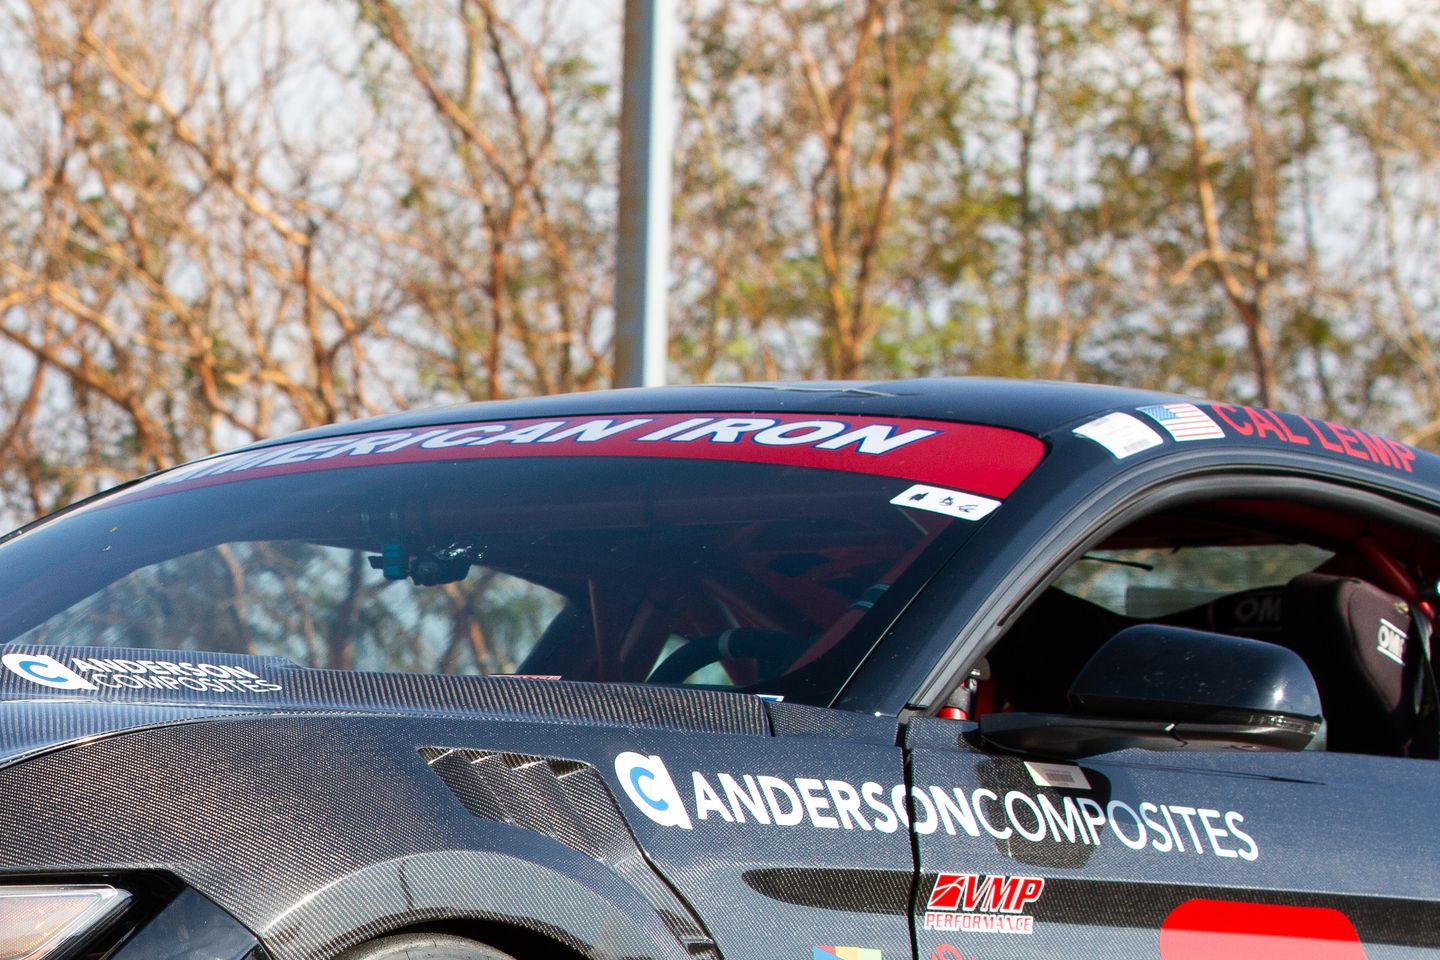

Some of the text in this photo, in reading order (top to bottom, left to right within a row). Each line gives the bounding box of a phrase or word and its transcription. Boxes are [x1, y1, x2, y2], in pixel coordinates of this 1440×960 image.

[637, 417, 942, 456] IRON
[1211, 403, 1310, 445] CAL
[1234, 597, 1282, 623] OM
[71, 657, 261, 680] ANDERSON
[91, 672, 283, 694] COMPOSITES
[962, 876, 1045, 913] VMP
[925, 912, 1033, 933] PERFORMANCE
